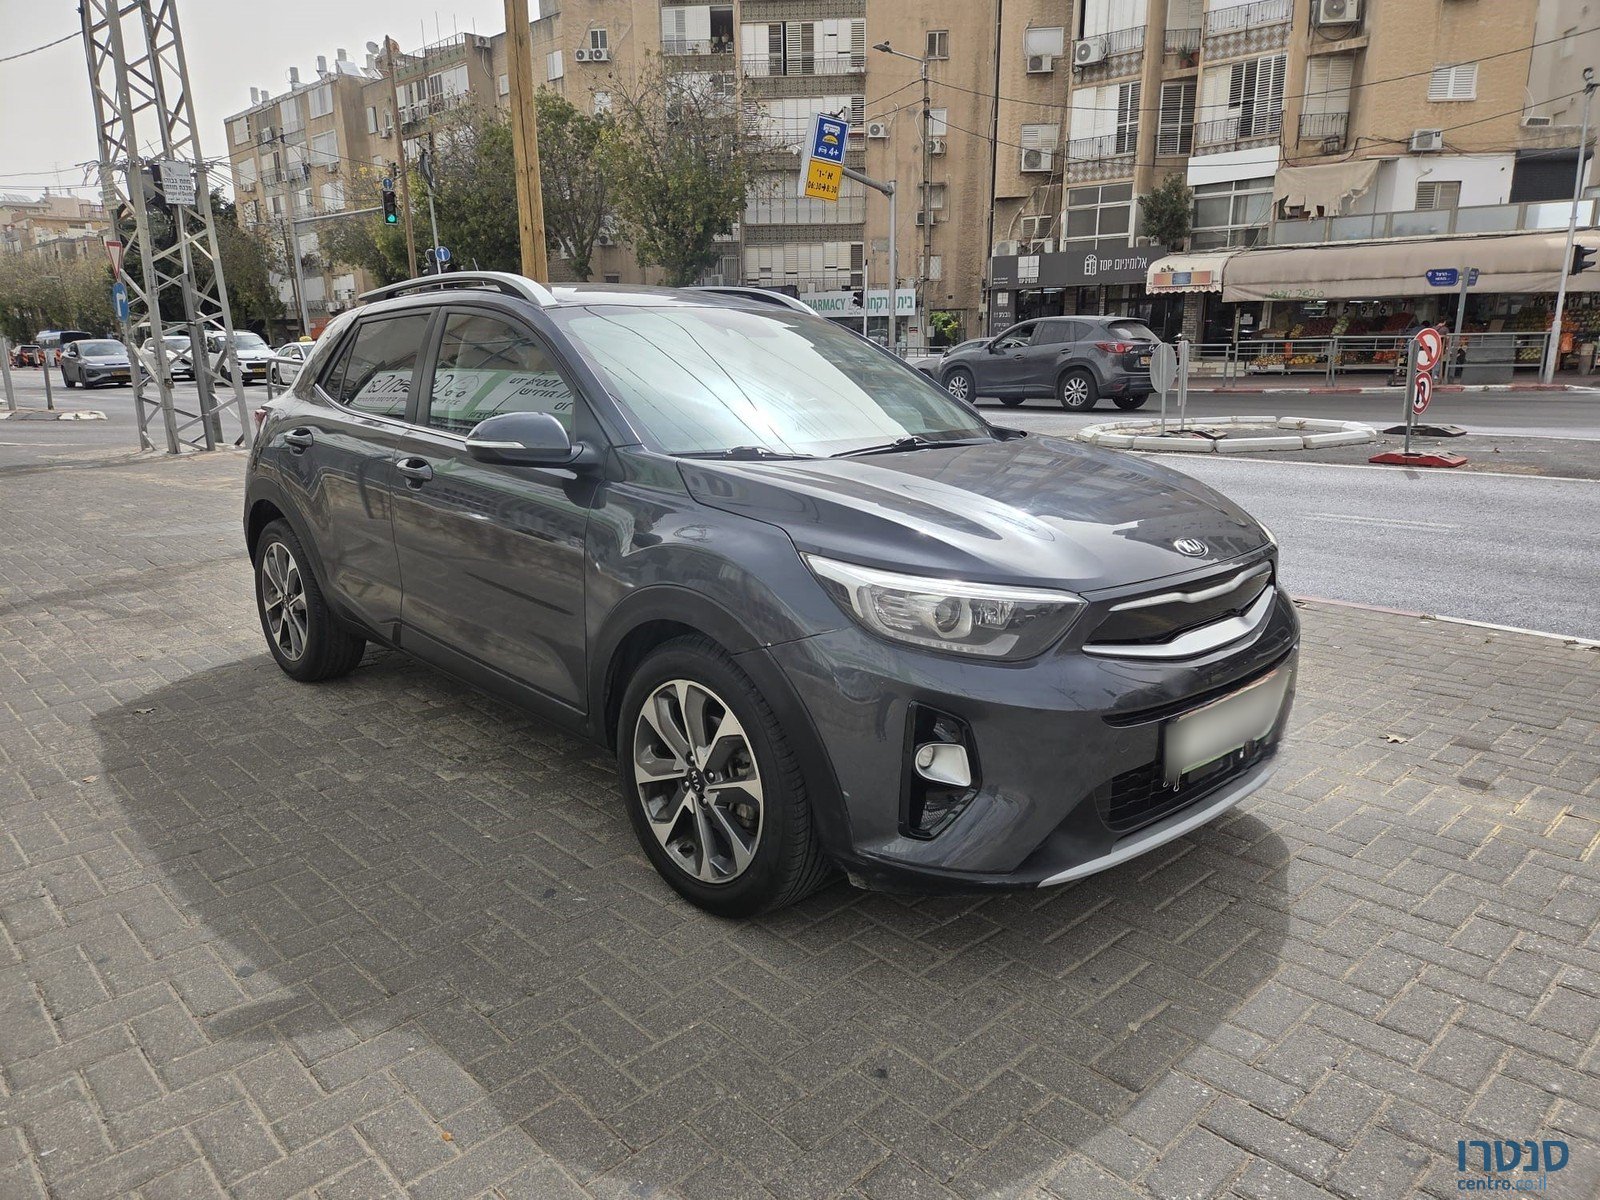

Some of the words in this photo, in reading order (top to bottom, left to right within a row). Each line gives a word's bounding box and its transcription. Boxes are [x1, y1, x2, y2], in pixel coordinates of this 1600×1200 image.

[1100, 259, 1113, 271] TOP
[1114, 256, 1148, 270] אלומיניום
[897, 295, 914, 309] בית
[690, 770, 701, 791] KIA
